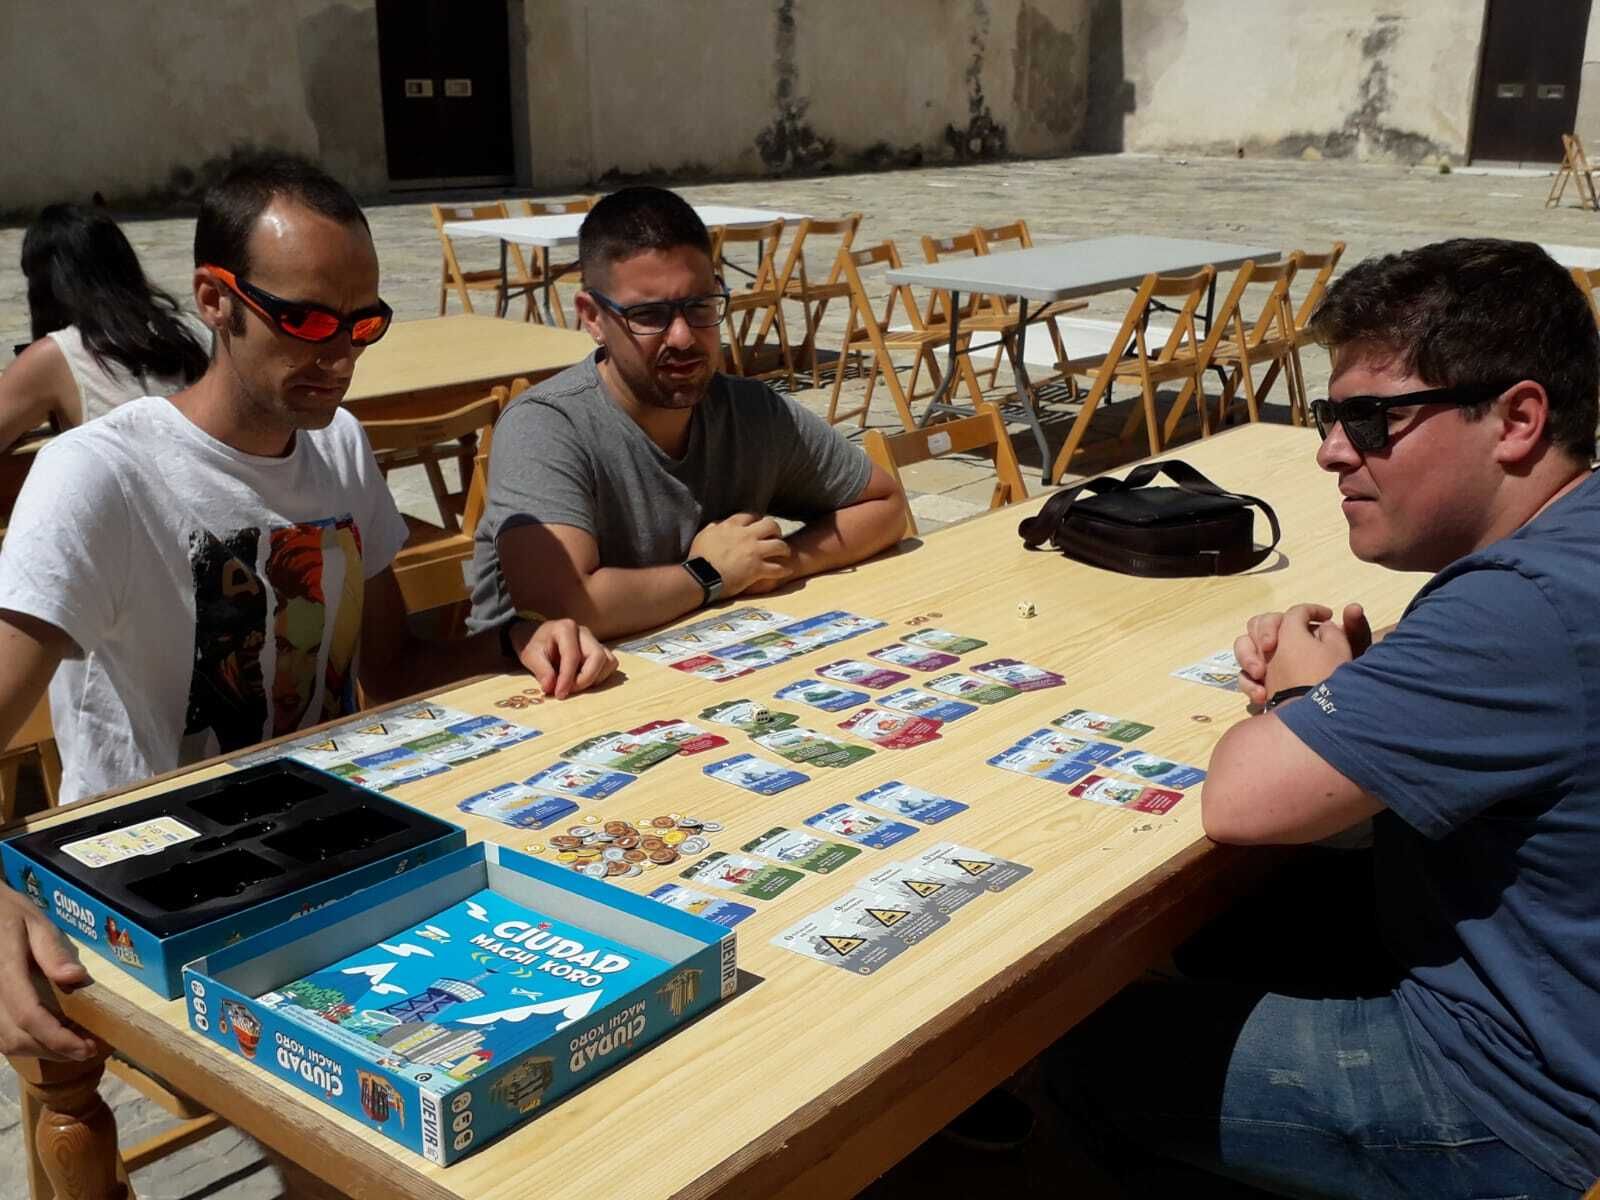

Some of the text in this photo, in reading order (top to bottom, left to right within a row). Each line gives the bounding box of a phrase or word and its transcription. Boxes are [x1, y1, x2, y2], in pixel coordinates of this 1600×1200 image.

[54, 889, 96, 929] CIUDAD
[469, 933, 604, 988] MACHI KORO
[493, 920, 631, 974] CIUDAD
[721, 937, 736, 983] DEVIR
[275, 1032, 305, 1056] KORO
[569, 999, 646, 1052] MACHI KORO
[569, 1015, 646, 1073] CIUDAD
[276, 1047, 344, 1097] CIUDAD
[308, 1048, 342, 1076] MACHI
[421, 1096, 439, 1147] DEVIR
